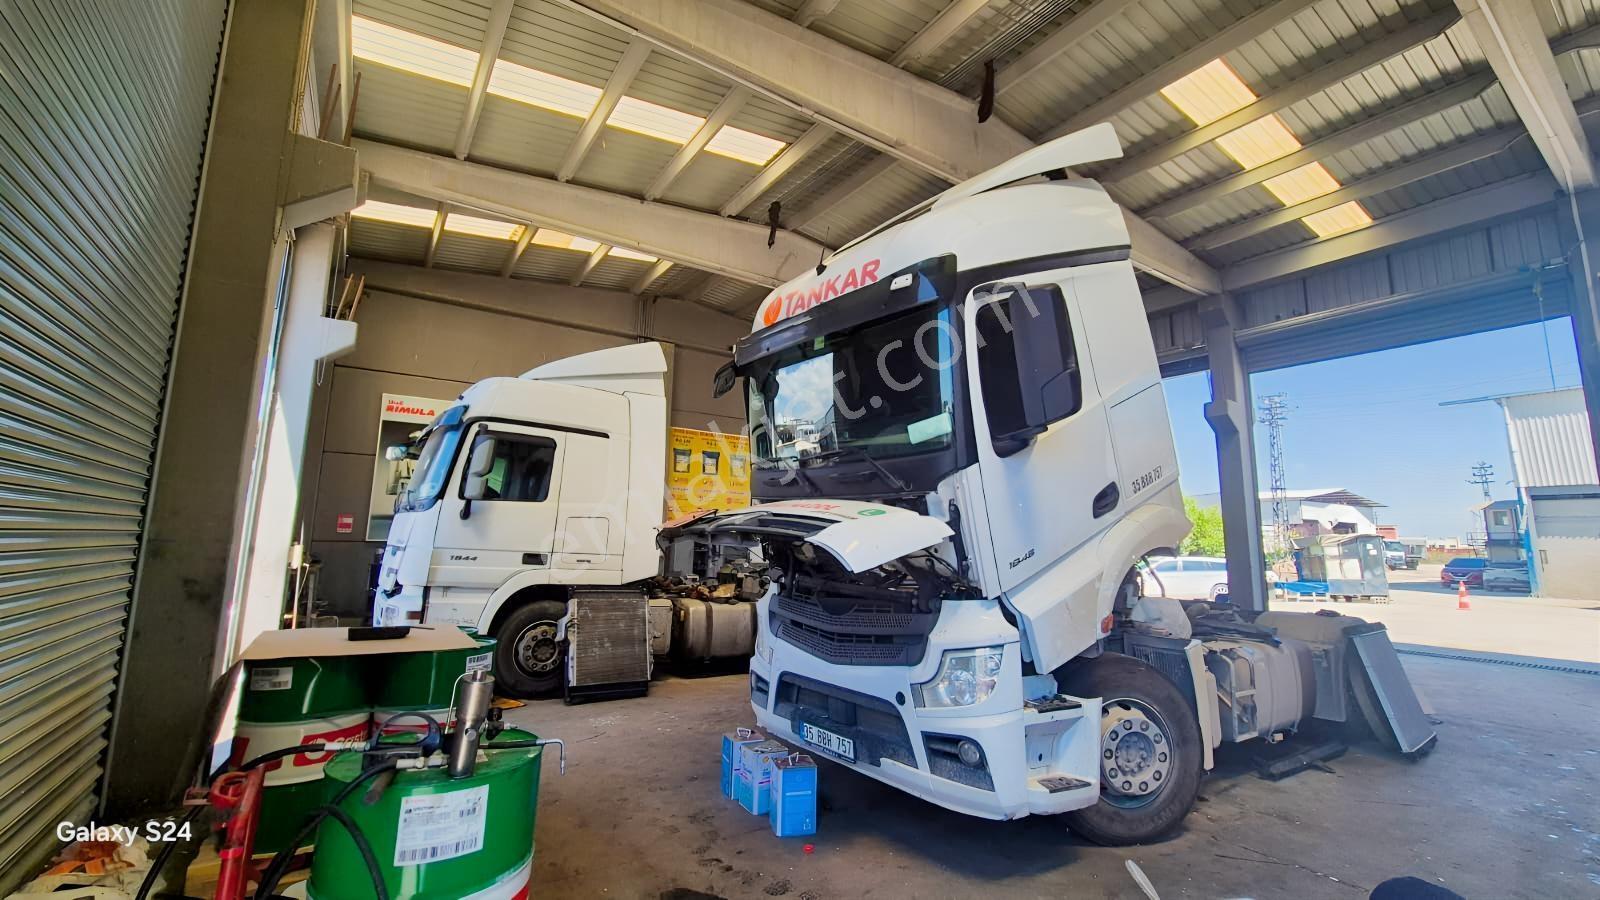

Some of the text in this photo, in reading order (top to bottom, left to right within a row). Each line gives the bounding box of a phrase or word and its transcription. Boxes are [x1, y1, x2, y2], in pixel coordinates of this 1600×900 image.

[784, 259, 881, 317] TANKAR
[385, 405, 436, 417] RIMULA
[1131, 478, 1141, 495] 35
[803, 724, 814, 741] 35
[816, 729, 832, 748] BBH
[836, 736, 852, 756] 757
